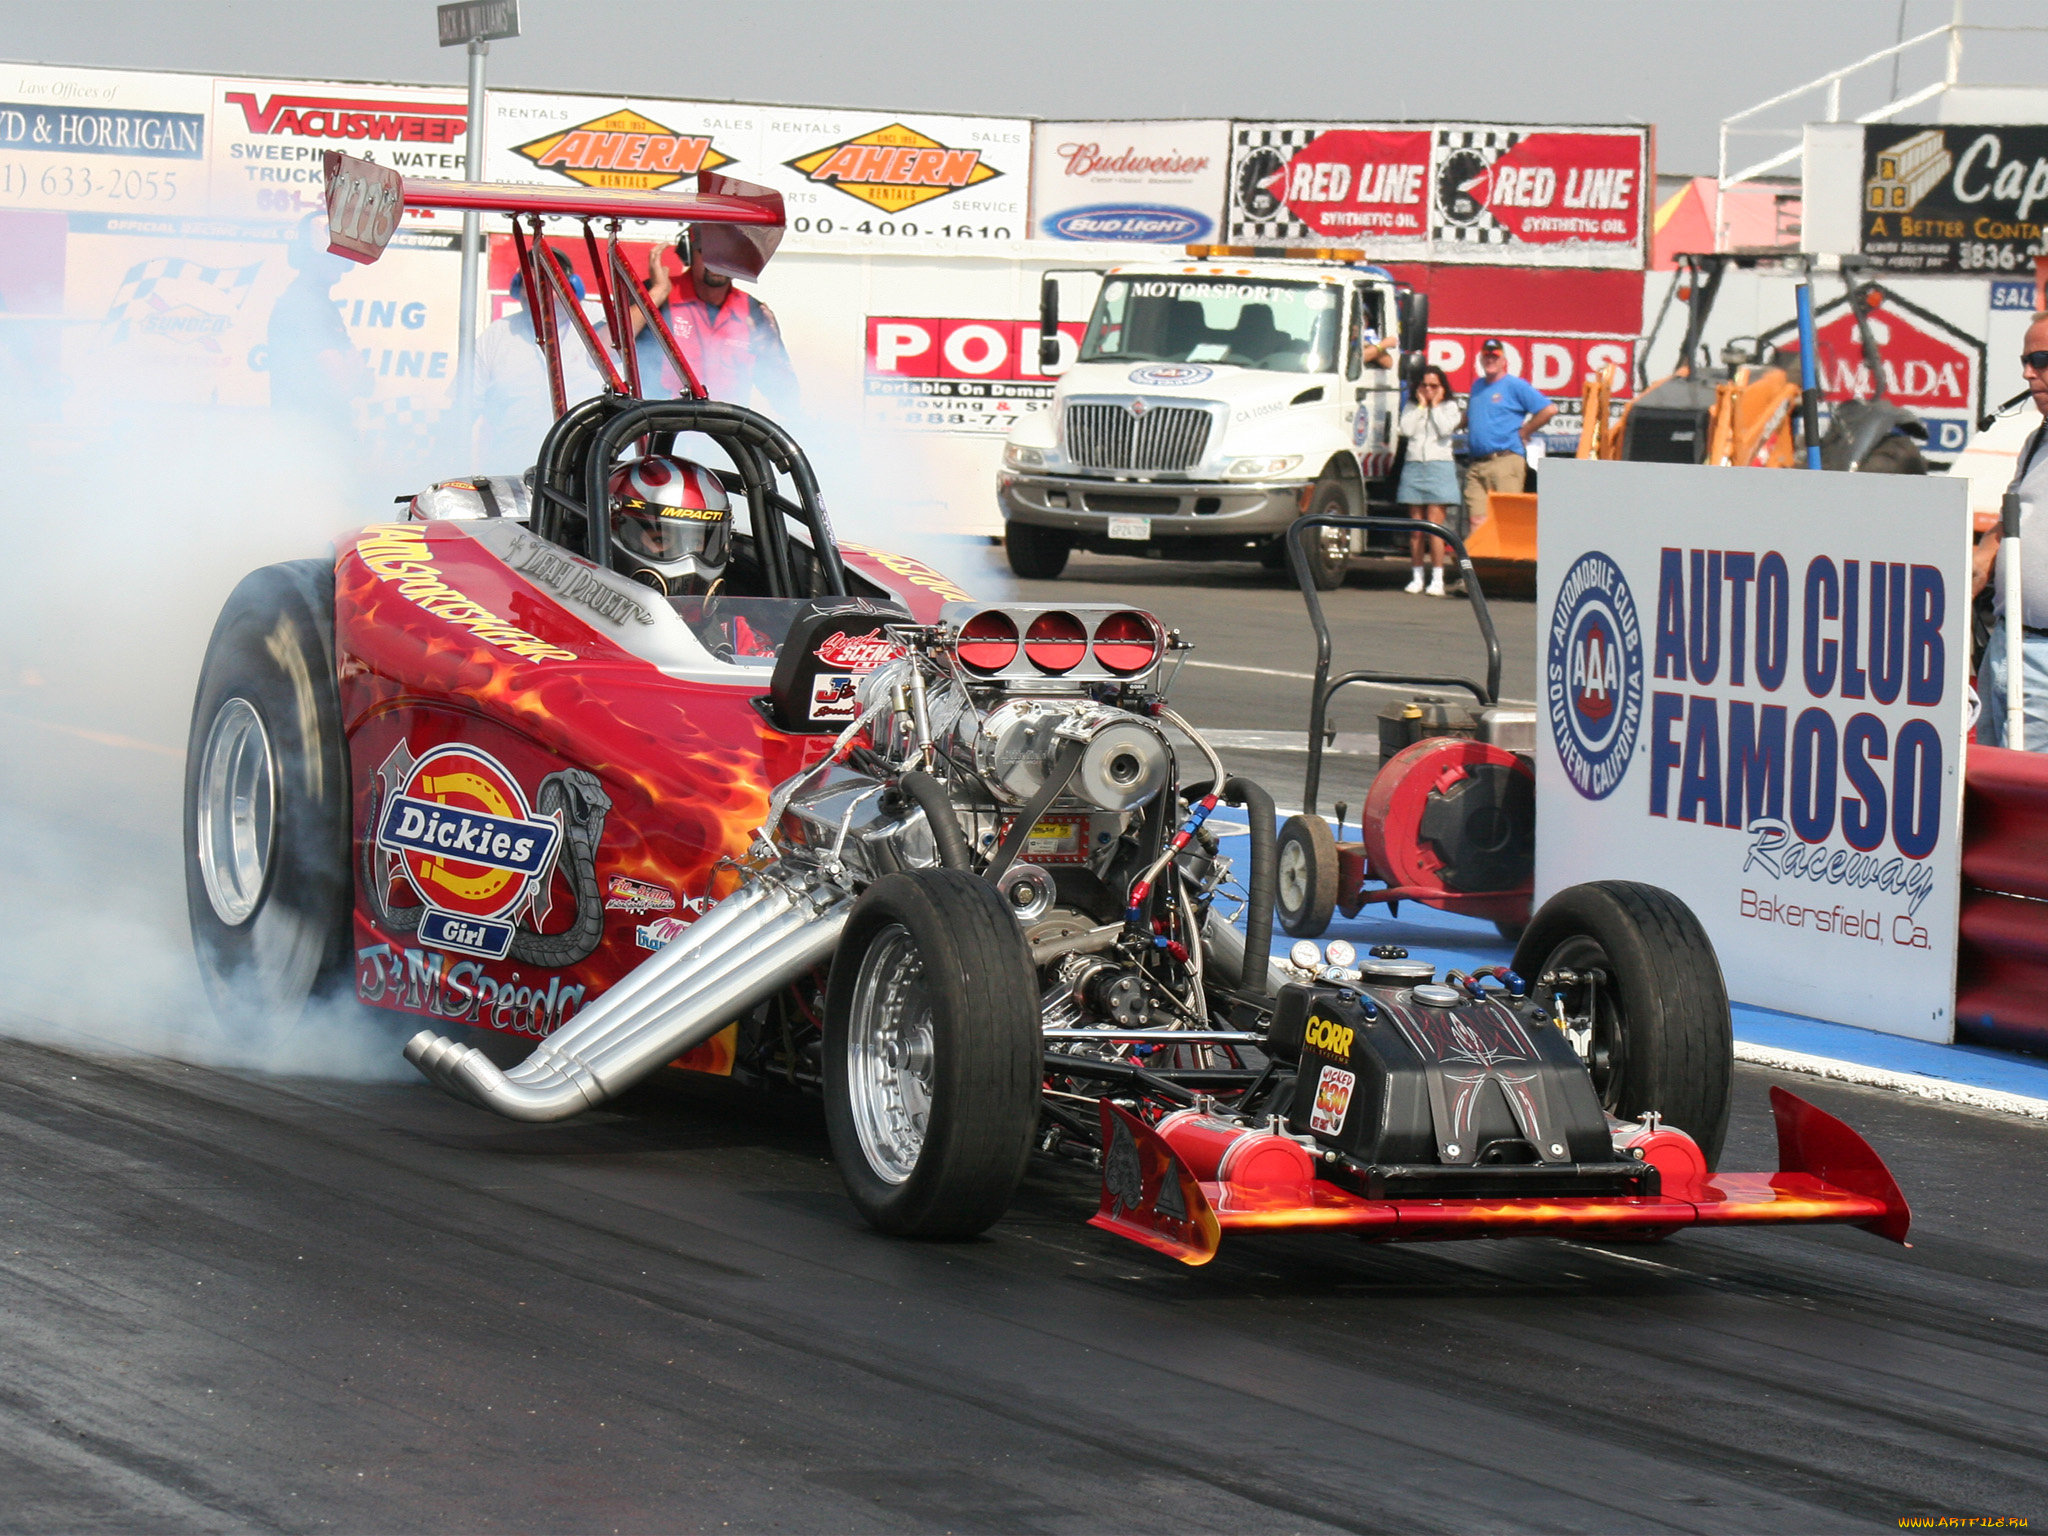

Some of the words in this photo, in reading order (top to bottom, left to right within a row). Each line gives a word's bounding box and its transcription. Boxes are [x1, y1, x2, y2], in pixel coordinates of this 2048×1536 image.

[18, 79, 47, 95] Law
[51, 81, 98, 99] Offices
[102, 84, 119, 101] of
[225, 92, 467, 144] VACUSWEEP
[497, 107, 569, 120] RENTALS
[702, 118, 753, 131] SALES
[32, 114, 51, 143] &
[58, 114, 198, 152] HORRIGAN
[771, 121, 841, 134] RENTALS
[971, 131, 1021, 144] SALES
[392, 152, 467, 169] WATER
[537, 130, 711, 173] AHERN
[810, 144, 981, 186] AHERN
[1057, 142, 1210, 176] Budweiser
[41, 164, 177, 201] 633-2055
[600, 173, 649, 188] RENTALS
[869, 188, 917, 201] RENTALS
[1289, 163, 1350, 202] RED
[1357, 164, 1425, 204] LINE
[1492, 166, 1556, 208] RED
[1563, 168, 1634, 210] LINE
[788, 192, 817, 203] RTS
[952, 200, 1018, 213] SERVICE
[794, 217, 1011, 239] 00-400-1610
[1066, 219, 1123, 233] BUD
[1124, 219, 1193, 233] LIGHT
[1320, 212, 1392, 227] SYNTHETIC
[1396, 213, 1418, 228] OIL
[1521, 216, 1599, 233] SYNTHETIC
[1601, 218, 1627, 234] OIL
[1870, 216, 1888, 237] A
[1901, 216, 1965, 238] BETTER
[1131, 281, 1294, 304] MOTORSPORTS
[1993, 286, 2035, 307] SAL
[144, 316, 226, 333] SUNOCO
[869, 381, 952, 396] Portable
[958, 384, 985, 396] On
[897, 399, 984, 412] Moving
[996, 401, 1011, 412] &
[1553, 558, 1613, 647] AUTOMOBILE
[1612, 585, 1640, 647] CLUB
[1653, 547, 1789, 692] AUTO
[1802, 554, 1946, 707] CLUB
[813, 628, 881, 657] Speed
[1573, 638, 1618, 700] AAA
[1549, 662, 1591, 792] SOUTHERN
[1592, 673, 1642, 794] CALIFORNIA
[1649, 691, 1943, 860] FAMOSO
[395, 806, 535, 863] Dickies
[1742, 815, 1934, 916] Raceway
[1740, 888, 1884, 946] Bakersfield,
[1892, 915, 1932, 950] Ca.
[441, 920, 486, 947] Girl
[1304, 1015, 1355, 1058] GORR
[1322, 1068, 1353, 1085] WICKED
[1316, 1081, 1349, 1115] 330
